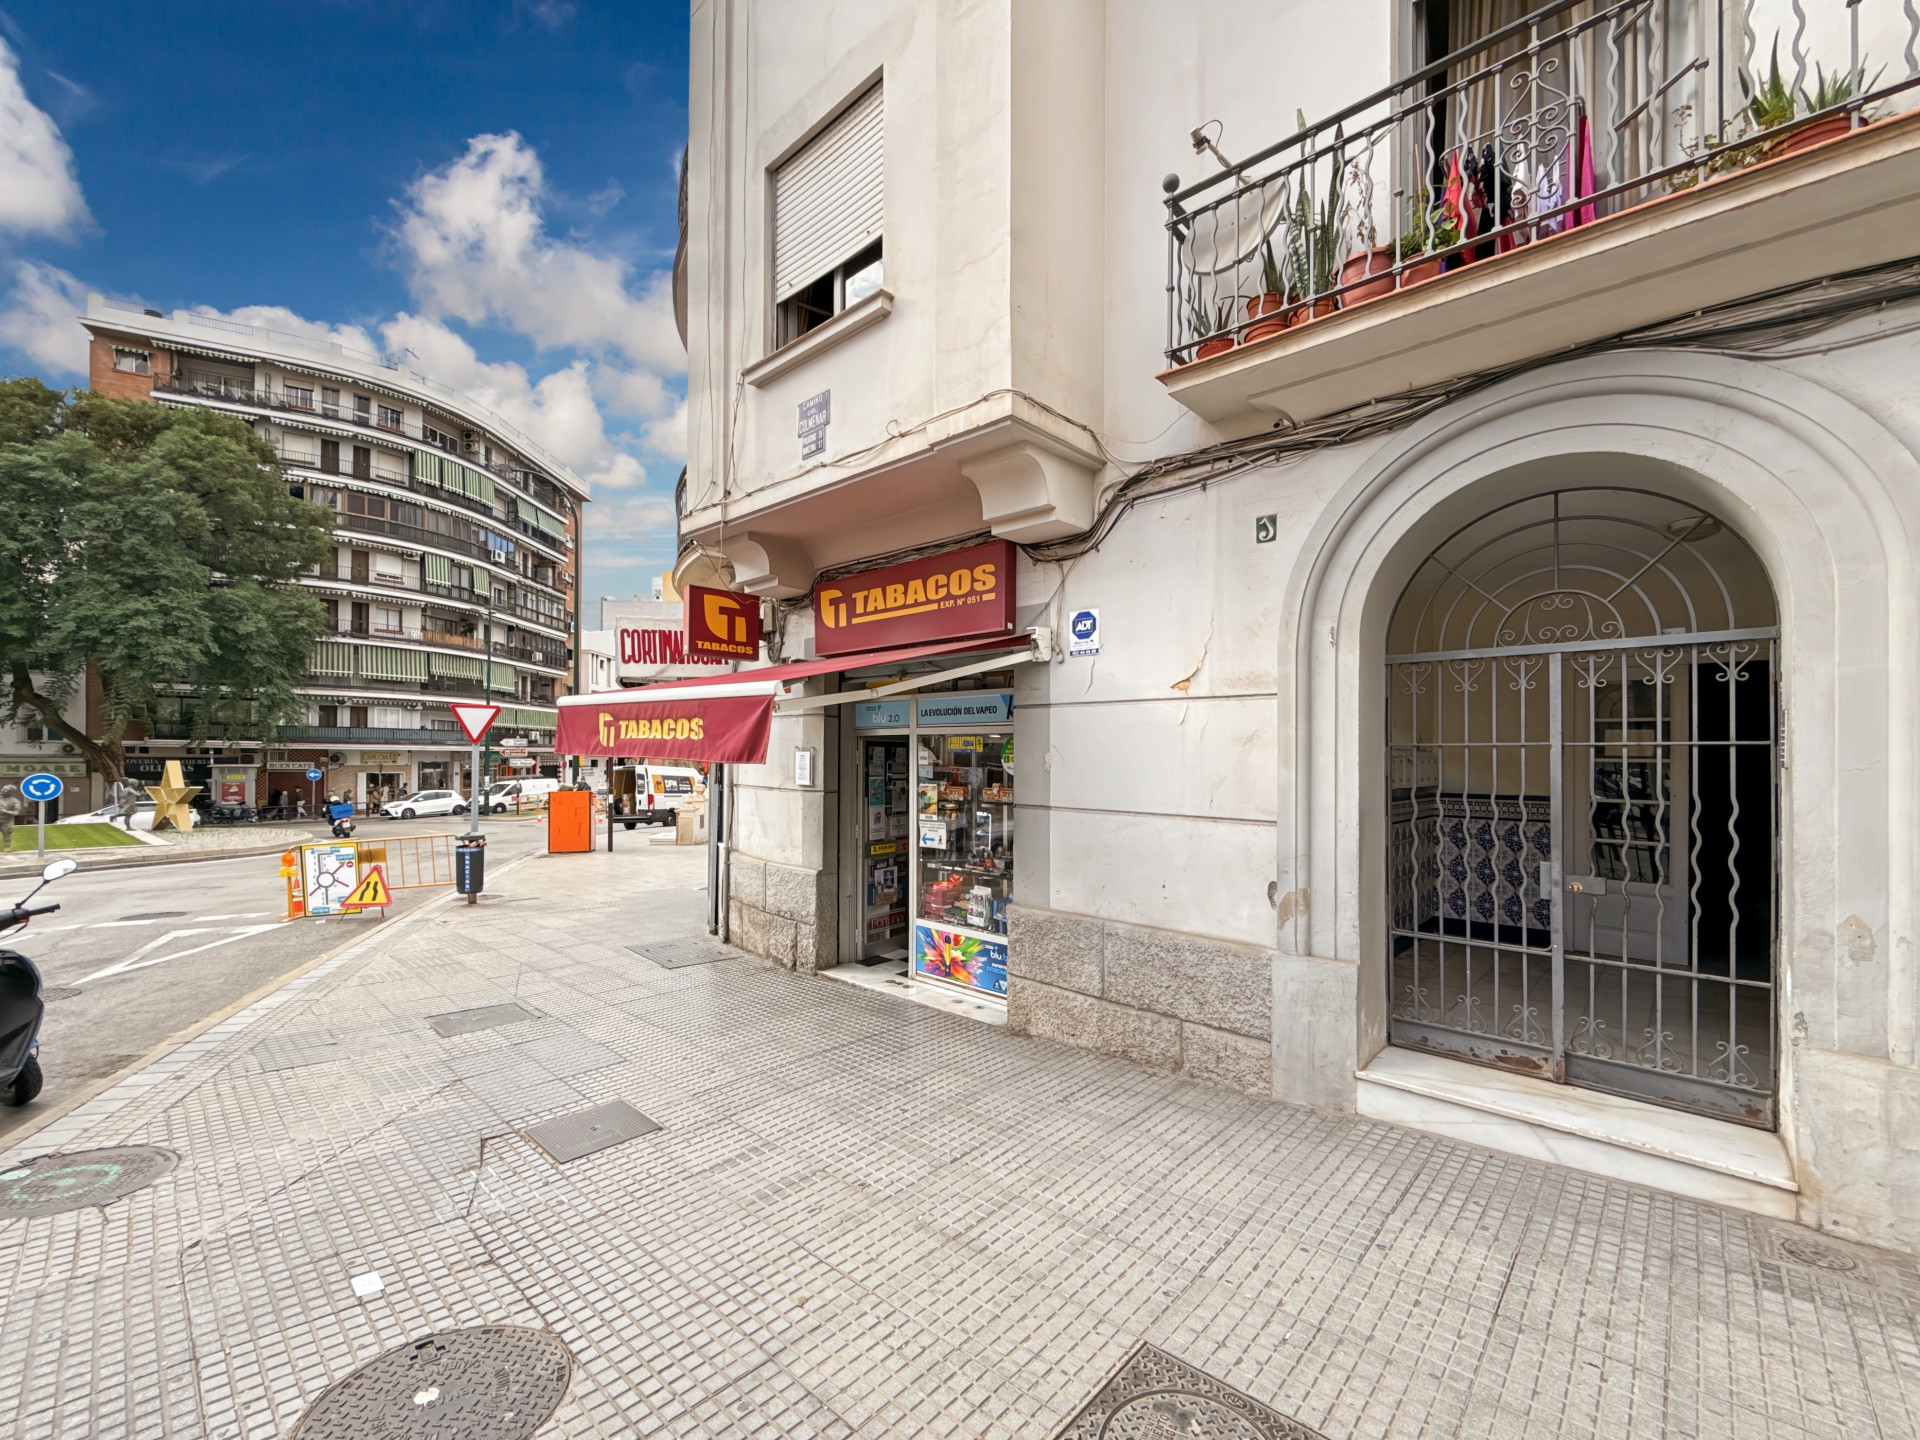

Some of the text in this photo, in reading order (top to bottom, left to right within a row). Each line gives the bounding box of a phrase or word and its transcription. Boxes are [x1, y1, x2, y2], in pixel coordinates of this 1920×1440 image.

[802, 393, 823, 411] CAMINO
[799, 410, 827, 433] COLMENAR
[851, 563, 997, 615] TABACOS
[940, 600, 956, 609] EXP.
[967, 595, 980, 605] 051
[1075, 619, 1093, 632] ADT
[696, 640, 754, 657] TABACOS
[872, 712, 900, 724] blu 2.0
[921, 705, 998, 717] LA EVOLUCIÓN DEL VAPEO
[618, 717, 705, 740] TABACOS
[6, 764, 82, 773] MOARE
[139, 764, 194, 772] OLLAS
